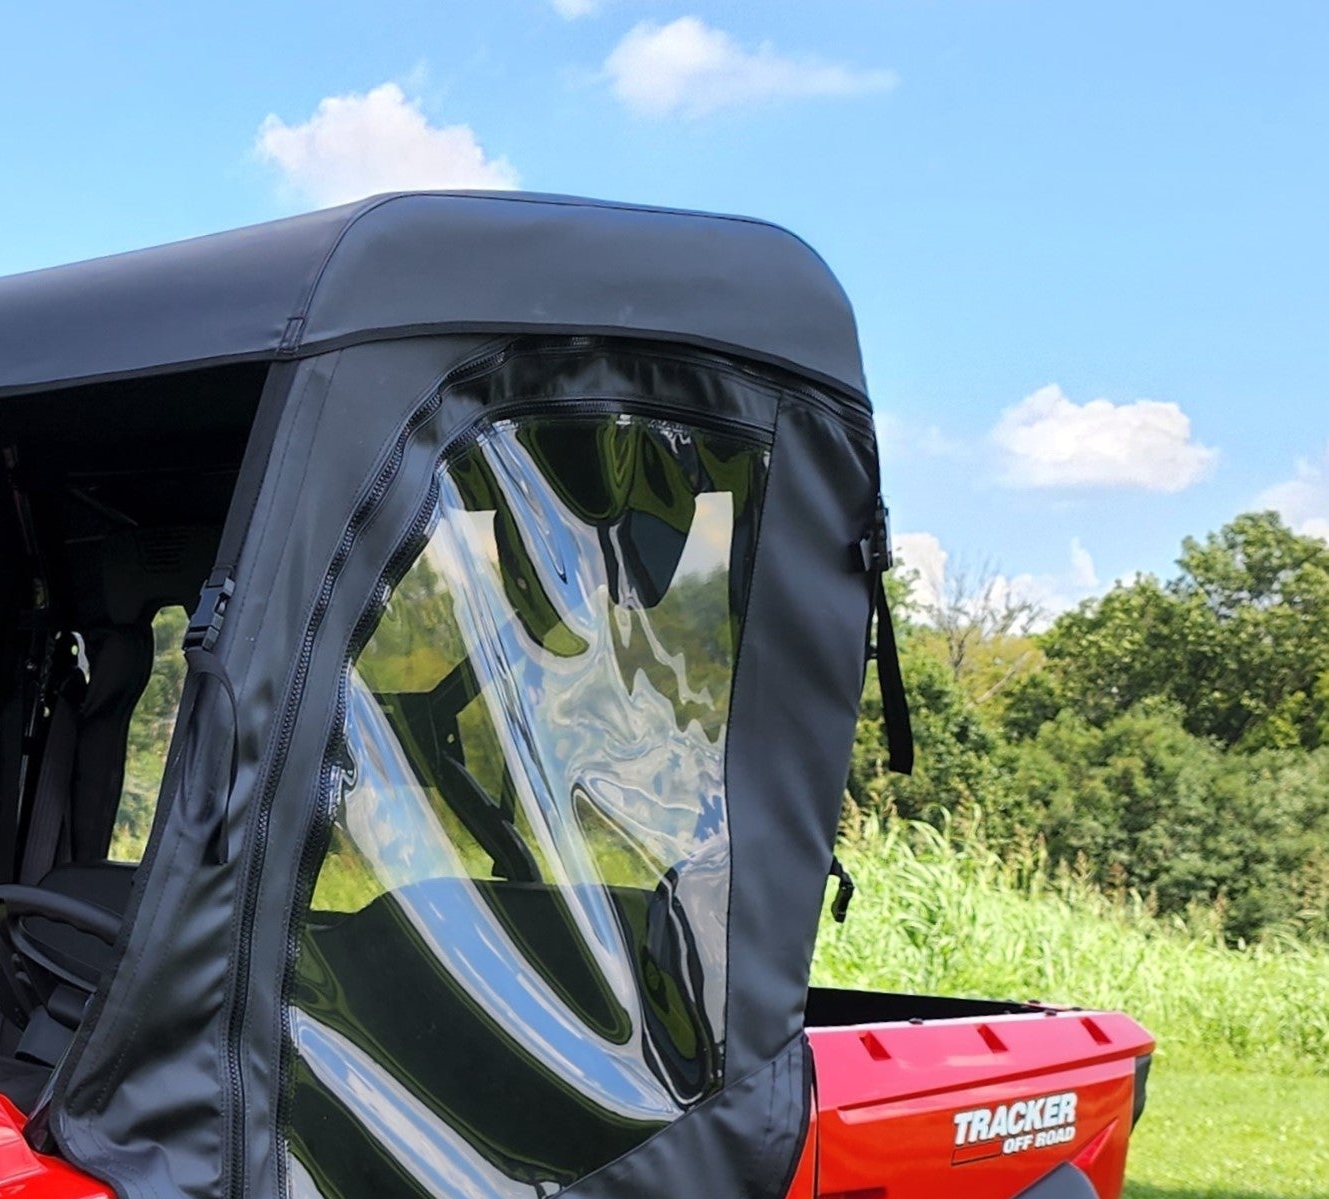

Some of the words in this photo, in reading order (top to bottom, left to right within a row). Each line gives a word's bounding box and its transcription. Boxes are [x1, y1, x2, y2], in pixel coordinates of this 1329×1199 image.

[953, 1091, 1078, 1146] TRACKER
[1002, 1135, 1034, 1155] OFF
[1034, 1126, 1076, 1148] ROAD
